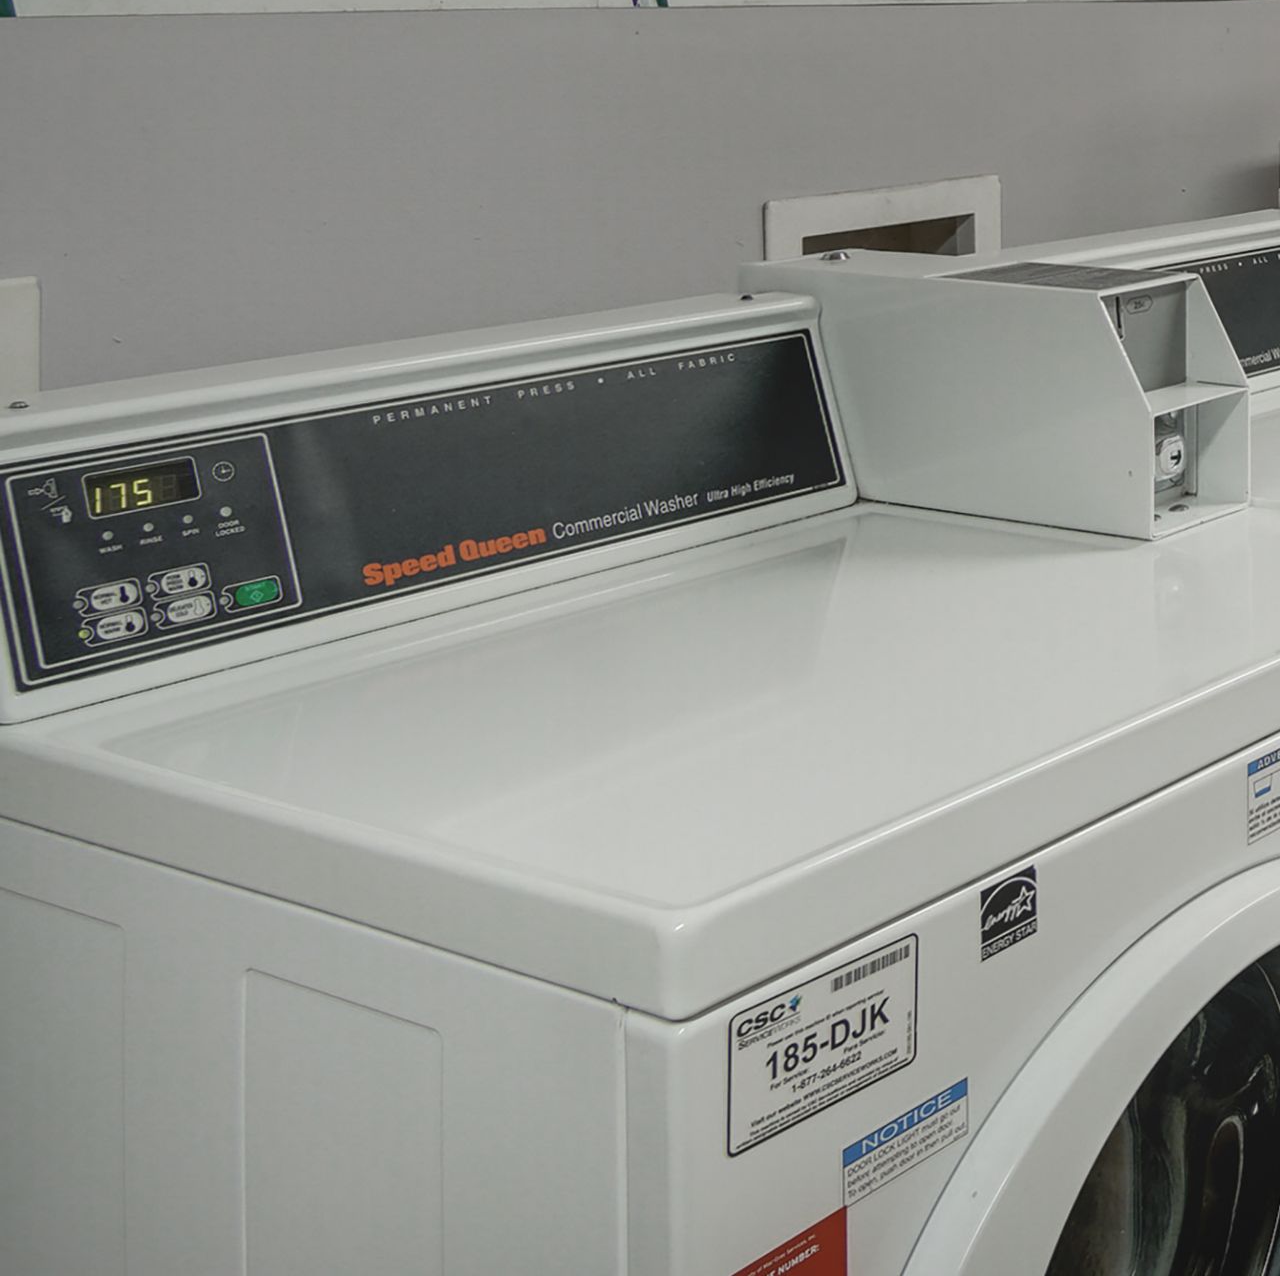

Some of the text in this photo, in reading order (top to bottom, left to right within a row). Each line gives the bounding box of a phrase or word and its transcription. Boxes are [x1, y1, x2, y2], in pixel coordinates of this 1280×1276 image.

[371, 351, 737, 426] PERMANENT PRESS ALL FABRIC
[92, 477, 154, 514] 175
[97, 520, 241, 553] WASH RINSE SPIN DOOR
[214, 527, 246, 536] LOCKED
[361, 472, 795, 586] Speed Queen Commercial Washer Ultra High Efficiency
[982, 919, 1037, 959] ENERGY STAR
[736, 1001, 786, 1040] CSC
[765, 995, 890, 1084] 185-DJK
[861, 1088, 952, 1155] NOTICE
[777, 1241, 819, 1276] NUMBER:
